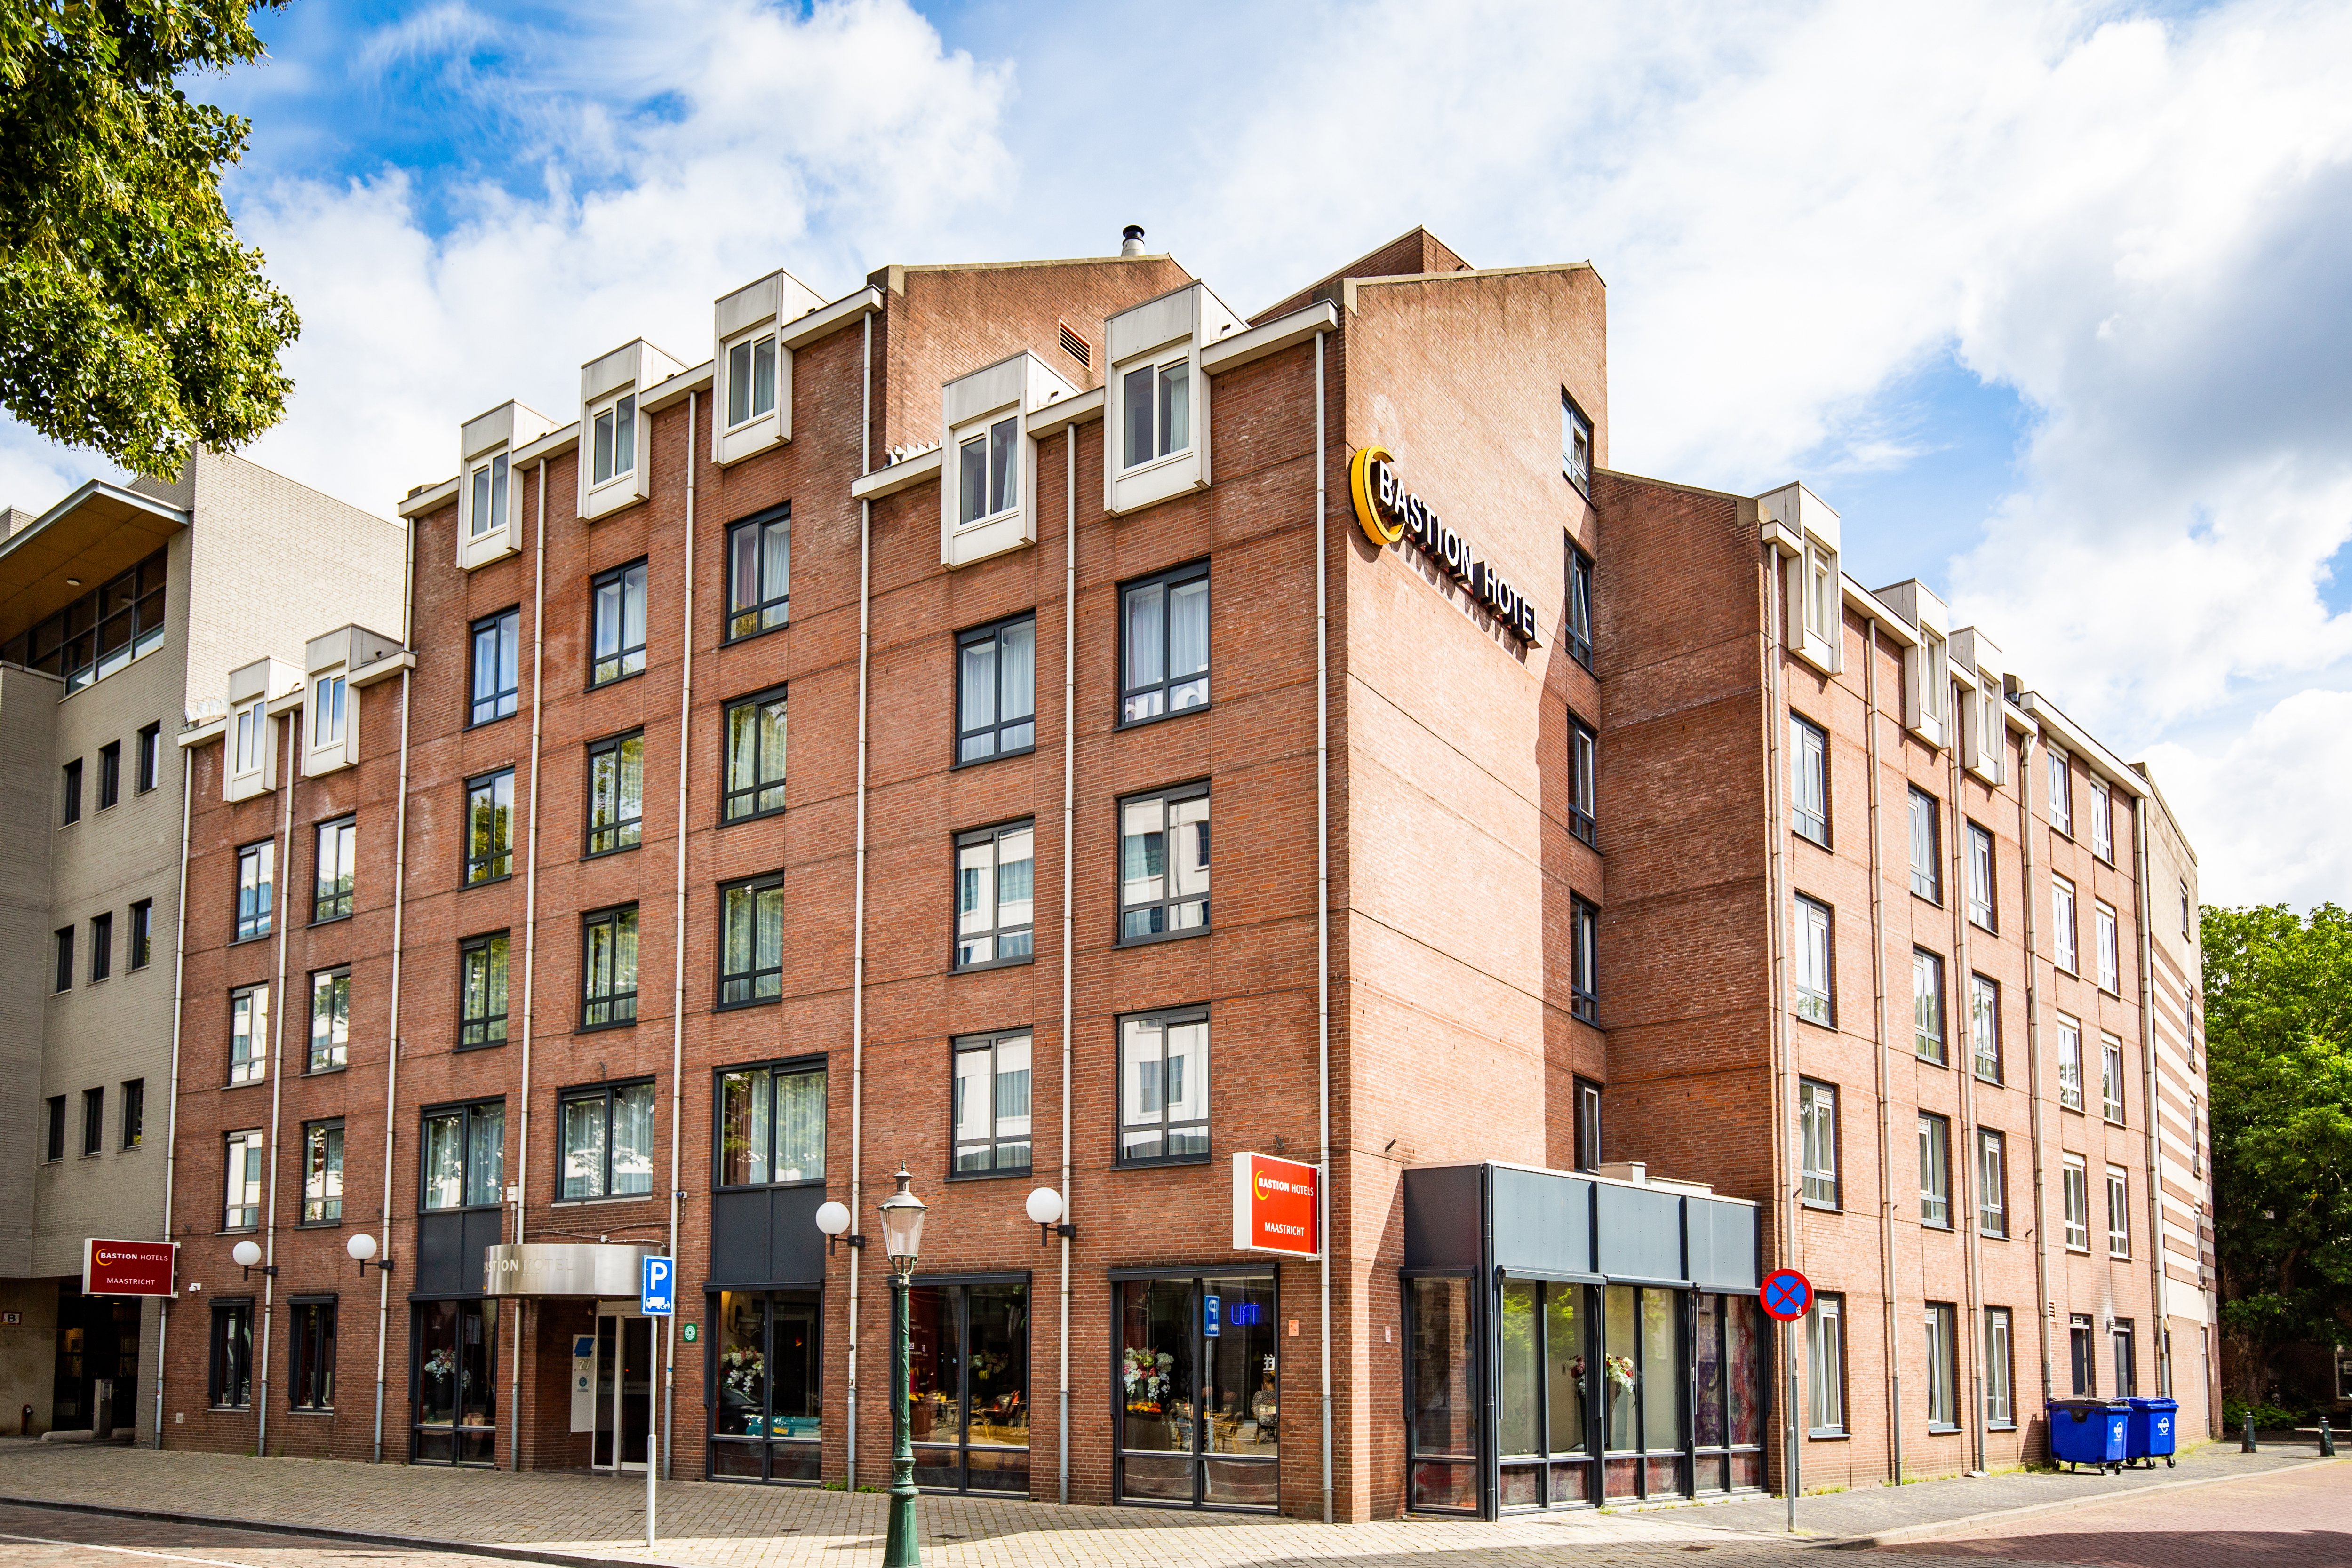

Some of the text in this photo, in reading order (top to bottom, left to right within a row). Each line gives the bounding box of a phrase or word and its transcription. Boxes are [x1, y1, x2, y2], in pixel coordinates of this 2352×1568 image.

[1378, 459, 1544, 648] BASTION HOTEL
[1258, 1177, 1314, 1196] BASTION HOTELS
[1265, 1222, 1305, 1237] MAASTRICHT
[523, 1258, 574, 1271] HOTEL
[651, 1261, 668, 1290] P
[1231, 1305, 1260, 1325] LIFT
[579, 1359, 590, 1371] 27
